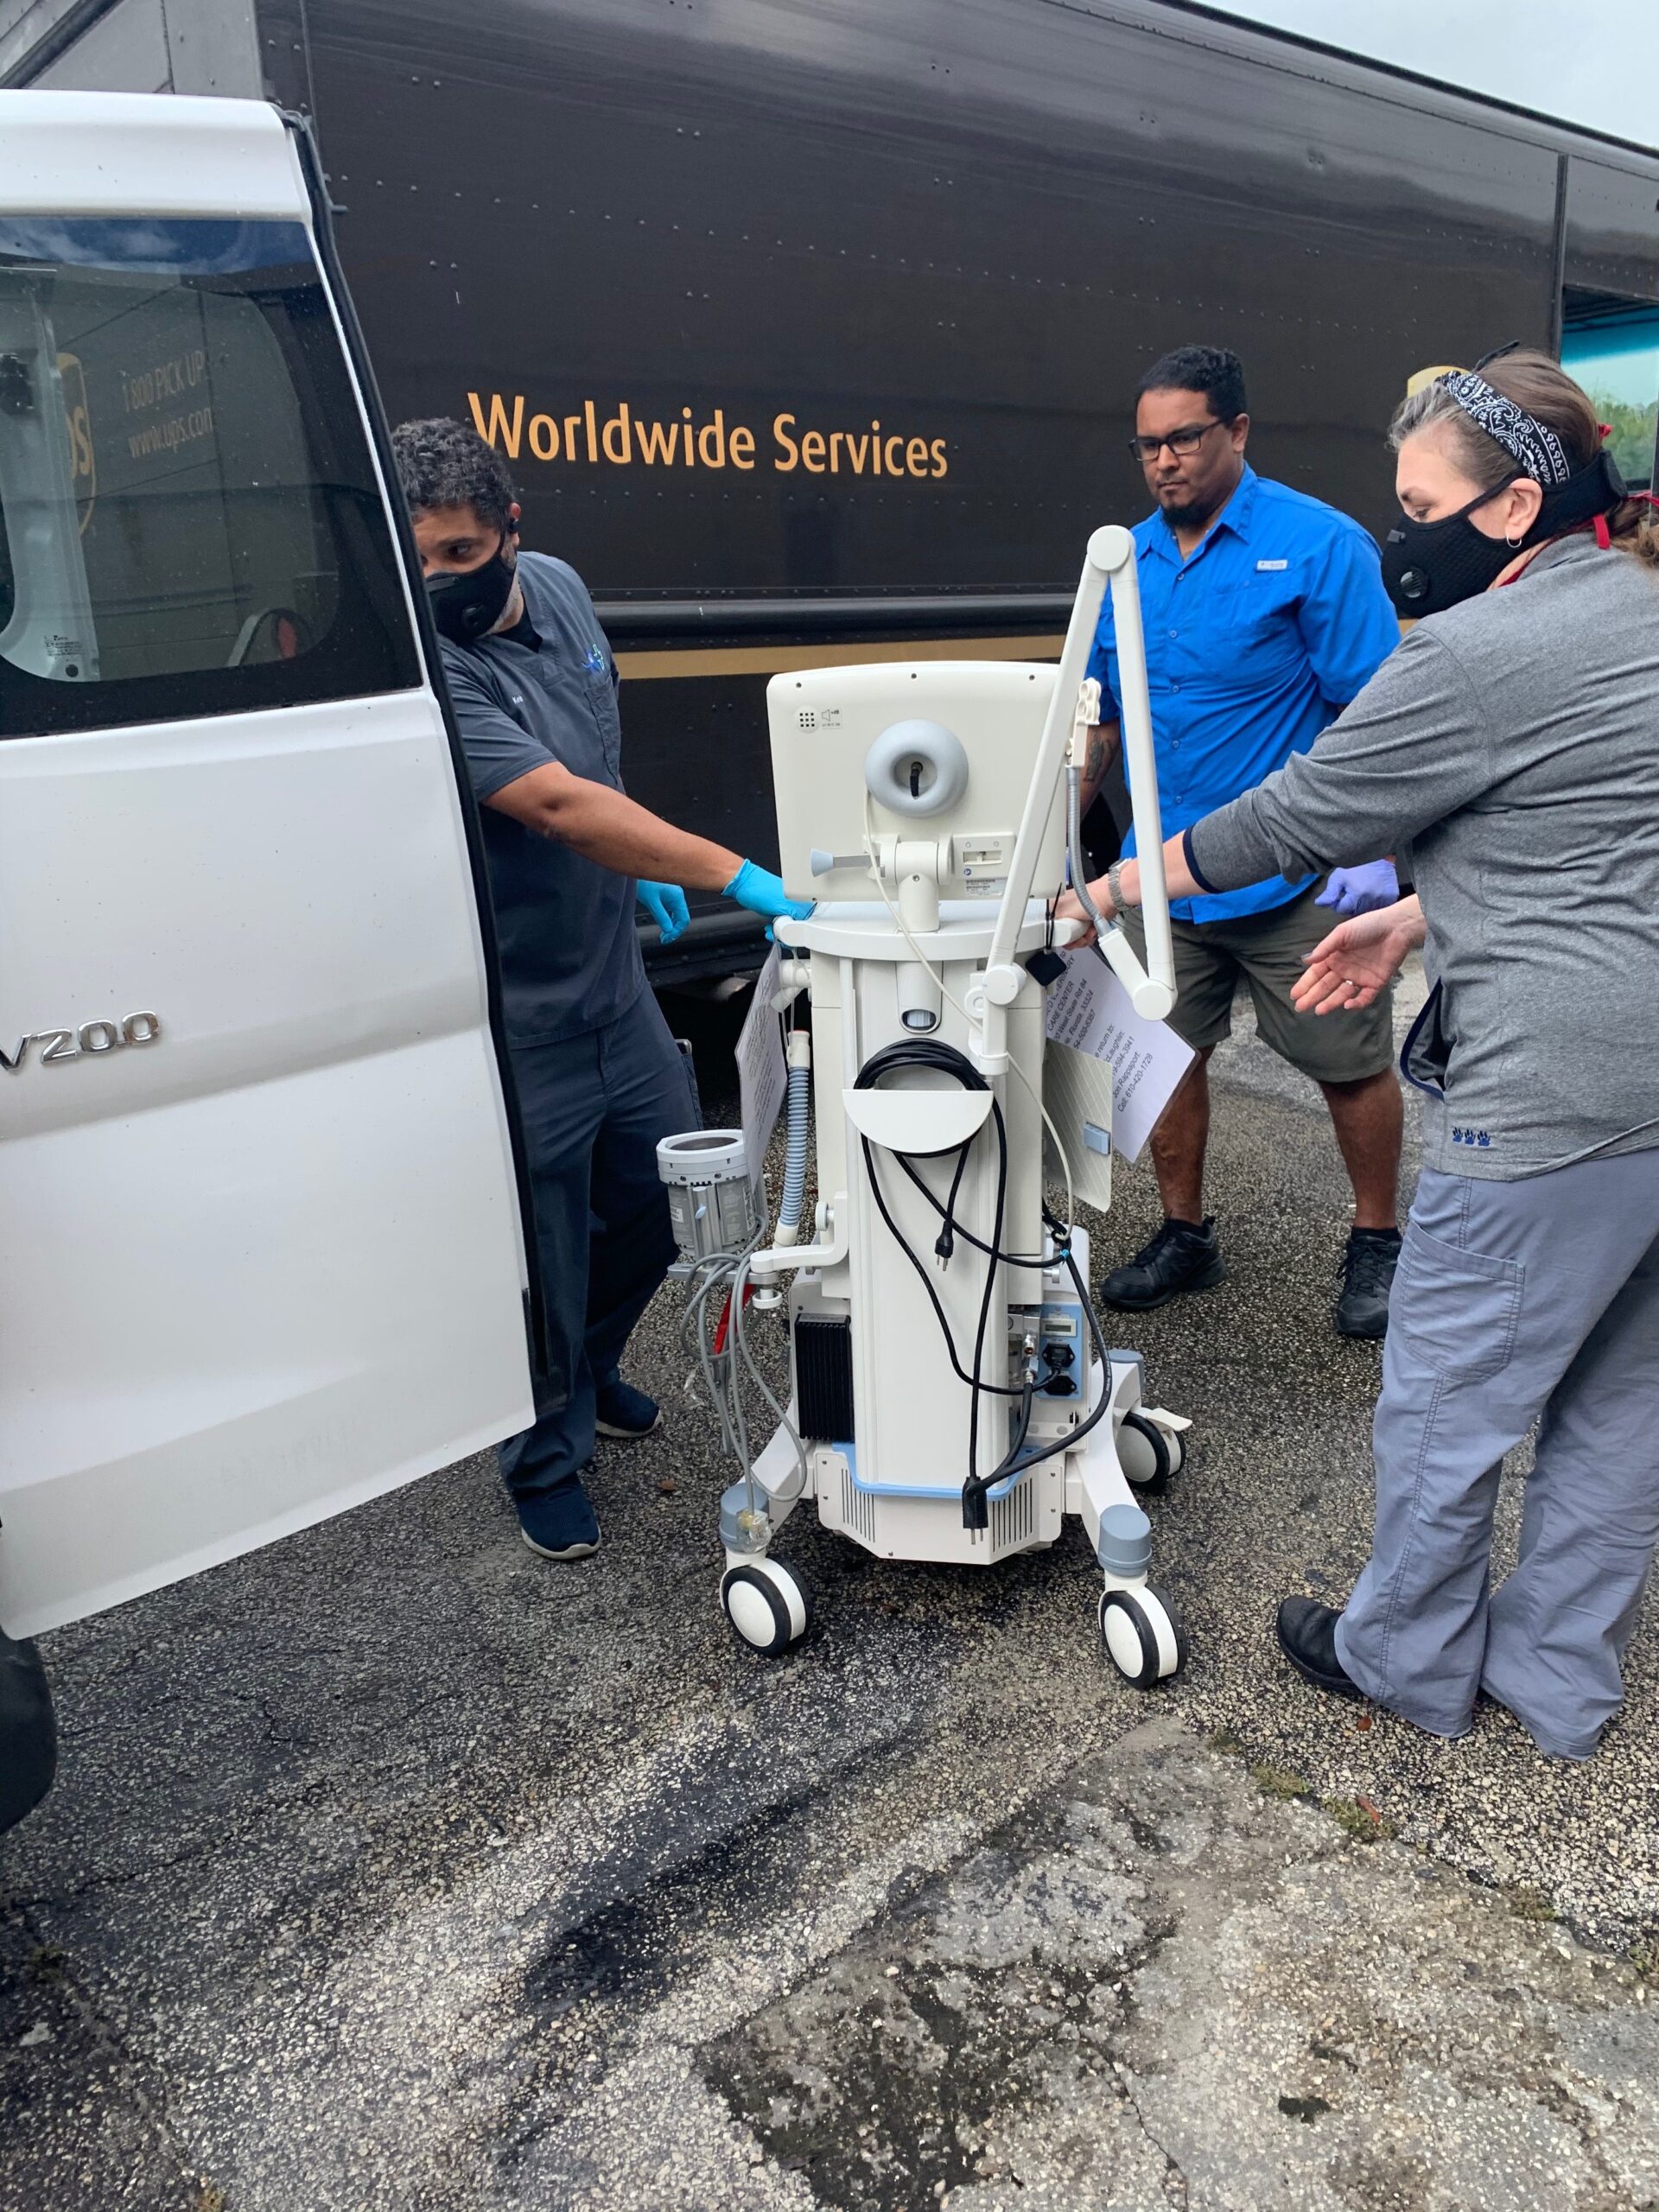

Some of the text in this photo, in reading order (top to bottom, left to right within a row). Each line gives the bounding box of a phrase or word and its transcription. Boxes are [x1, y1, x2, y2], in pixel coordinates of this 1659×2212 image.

[130, 372, 155, 410] 800
[154, 359, 186, 401] PICK
[467, 391, 948, 478] Worldwide Services
[1048, 1012, 1061, 1032] CARE
[1057, 981, 1075, 1011] CENTER
[0, 1010, 162, 1071] V200
[1097, 1033, 1109, 1053] return
[1103, 1030, 1126, 1064] cLaughlin:
[1112, 1035, 1135, 1080] 19-594-3941
[1118, 1051, 1141, 1086] Rappaport:
[1125, 1052, 1154, 1098] 610-420-1728
